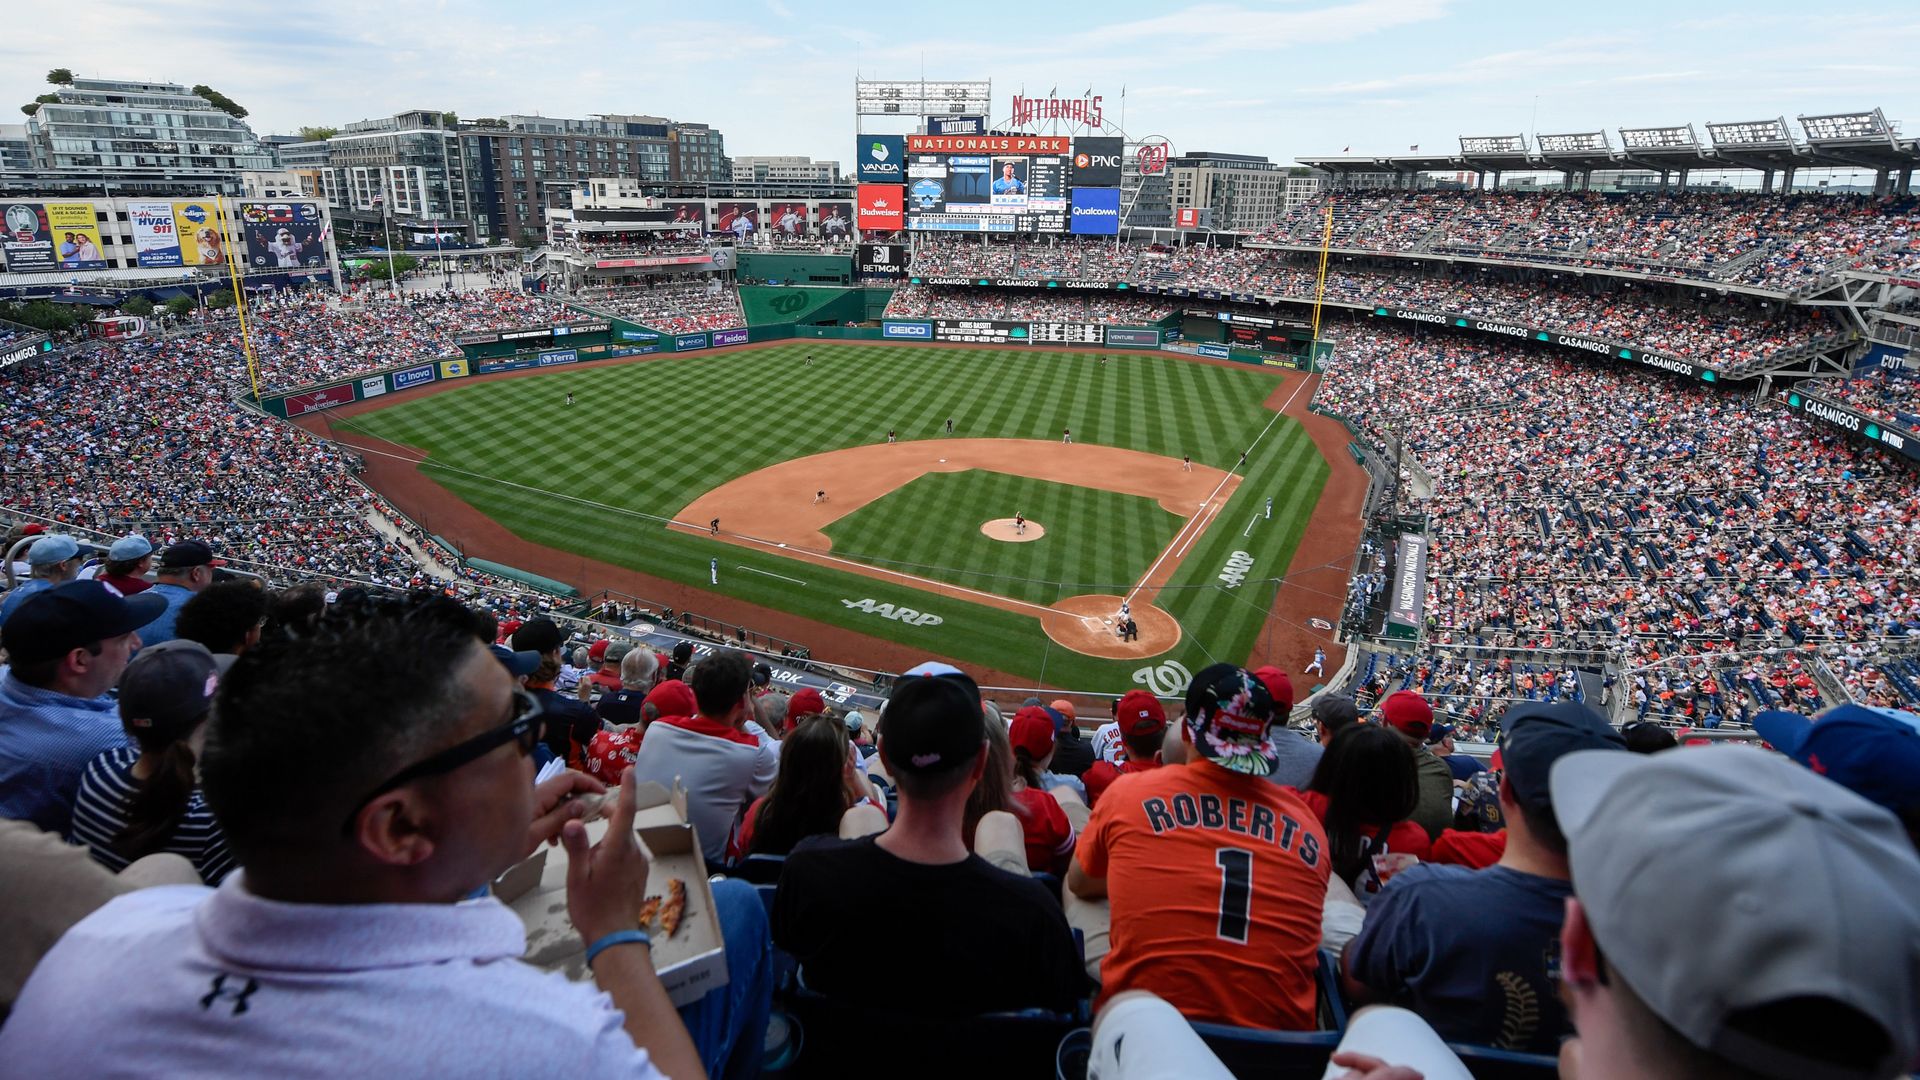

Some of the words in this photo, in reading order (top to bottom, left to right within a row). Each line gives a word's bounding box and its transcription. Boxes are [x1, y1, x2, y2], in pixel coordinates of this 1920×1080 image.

[1012, 95, 1102, 128] NATIONALS
[941, 120, 976, 132] NATITUDE
[914, 140, 1008, 149] NATIONALS
[1018, 140, 1061, 150] PARK
[1091, 156, 1120, 167] PNC
[1072, 206, 1116, 216] Qualcomm
[997, 280, 1039, 288] CASAMIGOS
[1397, 310, 1446, 324] CASAMIGOS
[1476, 322, 1528, 337] CASAMIGOS
[724, 334, 747, 342] leidos
[1558, 336, 1610, 354] CASAMIGOS
[0, 345, 37, 368] CASAMIGOS
[551, 354, 575, 362] Terra
[1642, 354, 1693, 376] CASAMIGOS
[408, 370, 430, 381] Inova
[364, 380, 384, 389] GDIT
[304, 398, 338, 412] Budweiser
[1805, 399, 1860, 431] CASAMIGOS
[1405, 543, 1419, 571] NATIONALS
[1218, 551, 1255, 589] AARP
[1400, 571, 1416, 610] WASHINGTON
[841, 598, 943, 626] AARP
[1142, 792, 1319, 868] ROBERTS
[1216, 847, 1253, 945] 1
